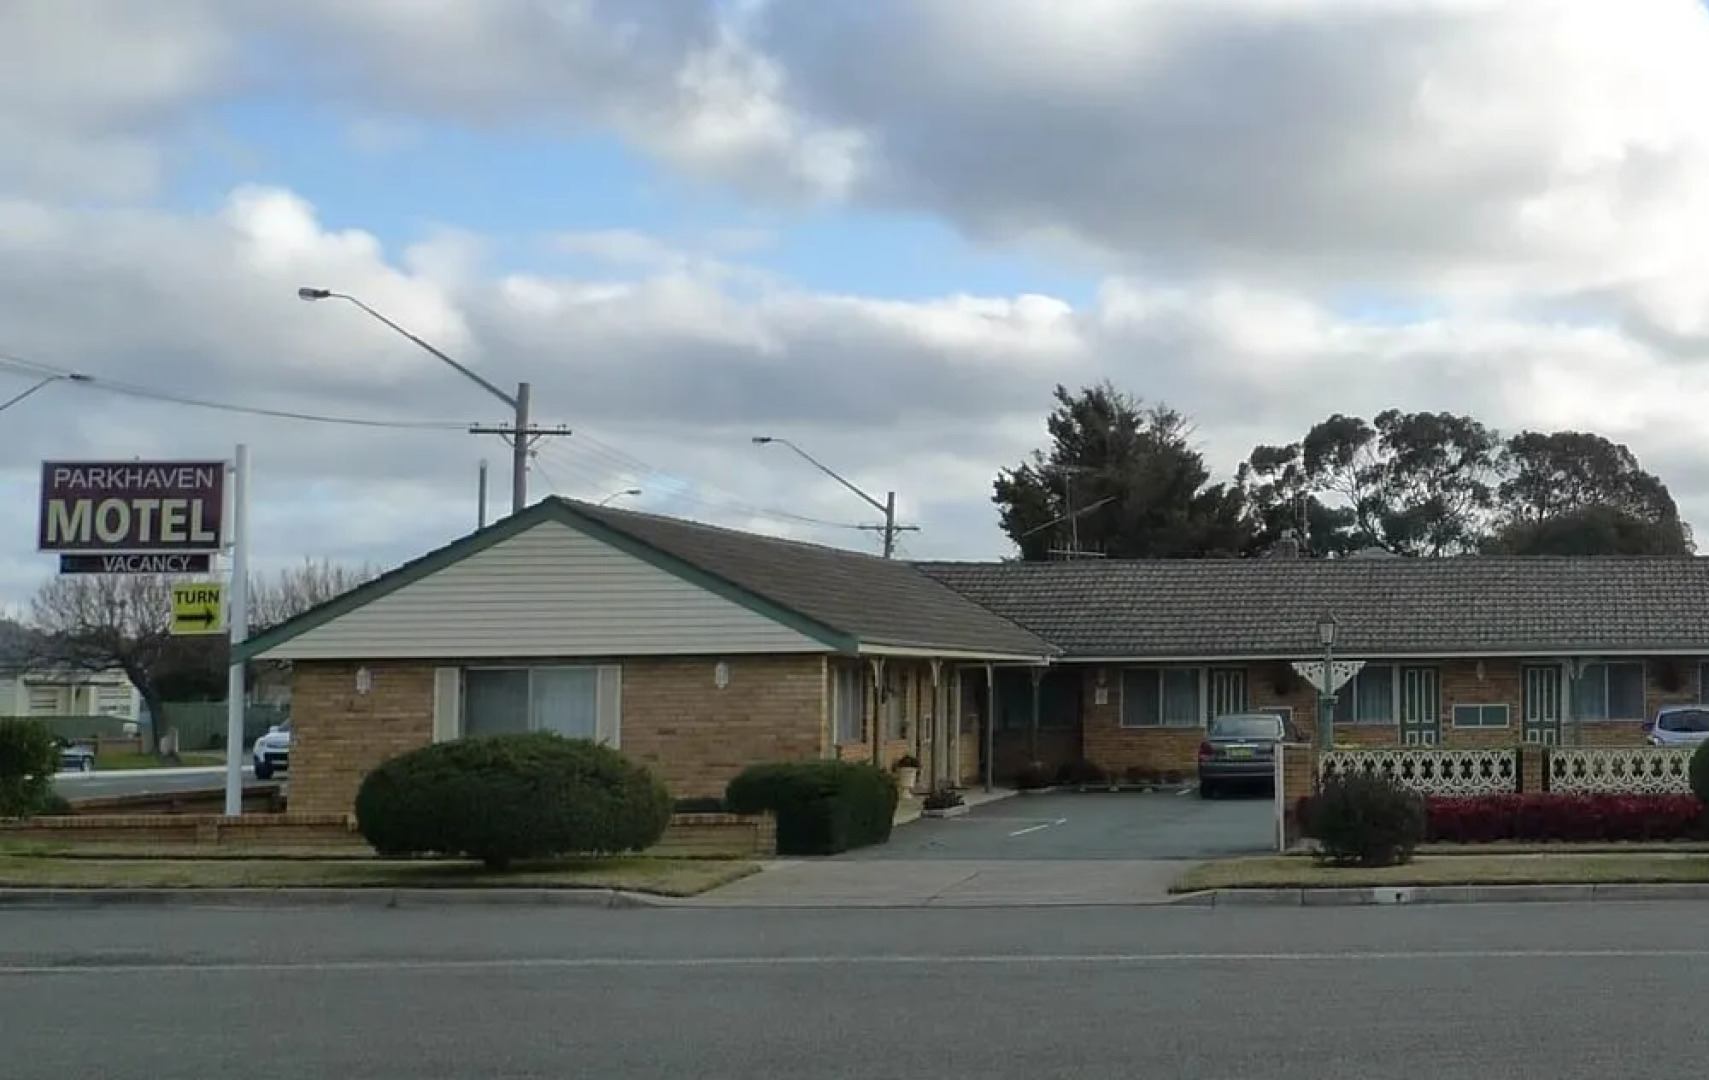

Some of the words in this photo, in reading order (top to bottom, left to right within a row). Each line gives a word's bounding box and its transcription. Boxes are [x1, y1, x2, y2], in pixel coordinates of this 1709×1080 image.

[54, 467, 213, 488] PARKHAVEN
[47, 498, 215, 543] MOTEL
[103, 556, 191, 572] VACANCY
[174, 590, 220, 604] TURN
